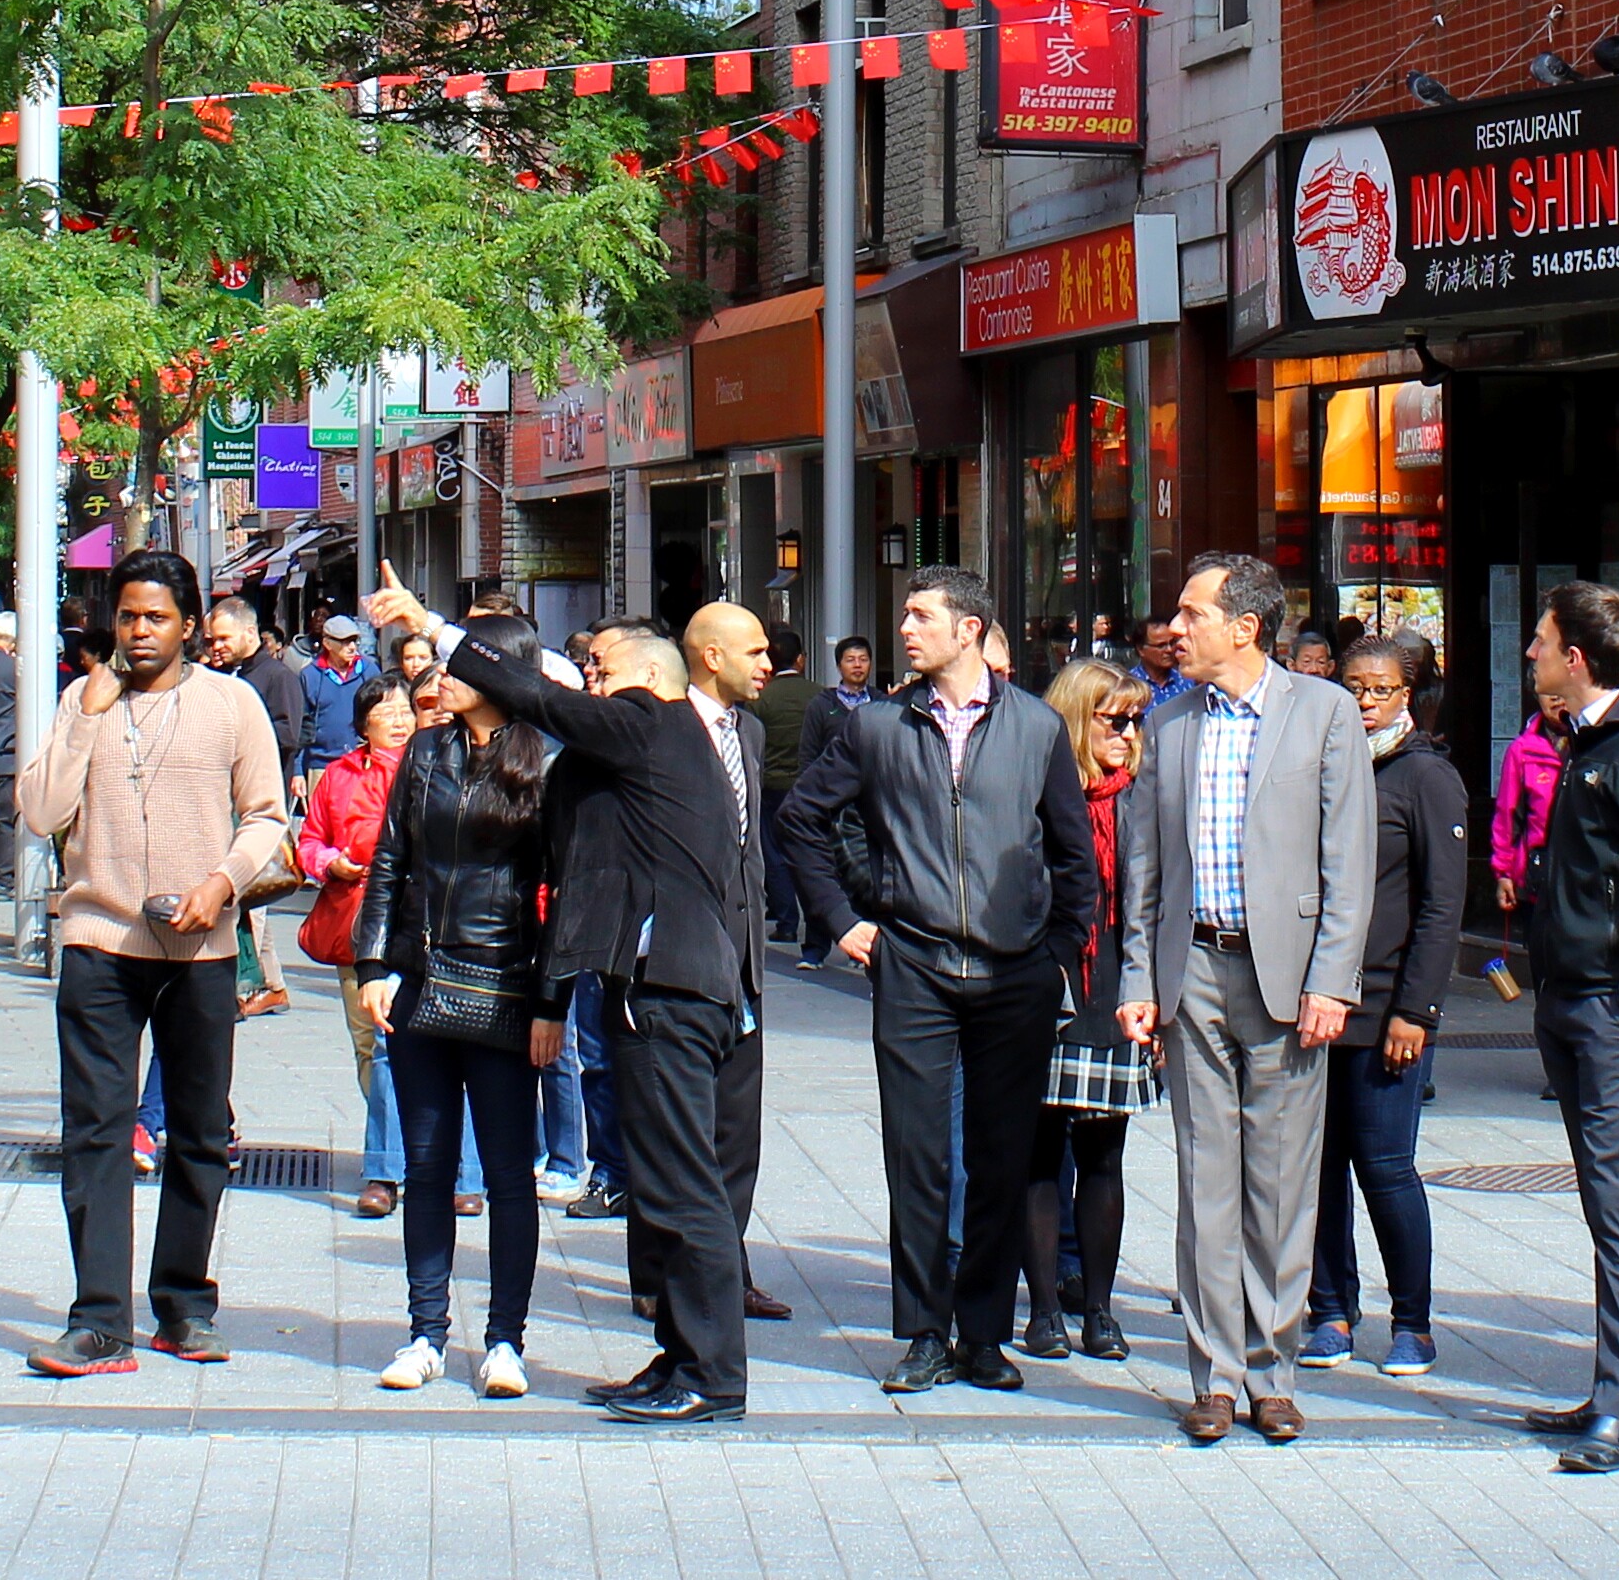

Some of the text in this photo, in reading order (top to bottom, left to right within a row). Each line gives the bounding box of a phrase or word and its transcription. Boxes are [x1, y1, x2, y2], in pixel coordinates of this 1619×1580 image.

[1019, 84, 1117, 100] The Cantonese
[1019, 95, 1115, 112] Restaurant
[1002, 114, 1133, 135] 514-397-9410
[1476, 109, 1582, 151] RESTAURANT
[1411, 163, 1499, 251] MON
[967, 256, 1050, 306] Restaurant Cuisine
[979, 302, 1033, 343] Cantonaise
[264, 460, 317, 472] Chatime
[1157, 478, 1172, 519] 84
